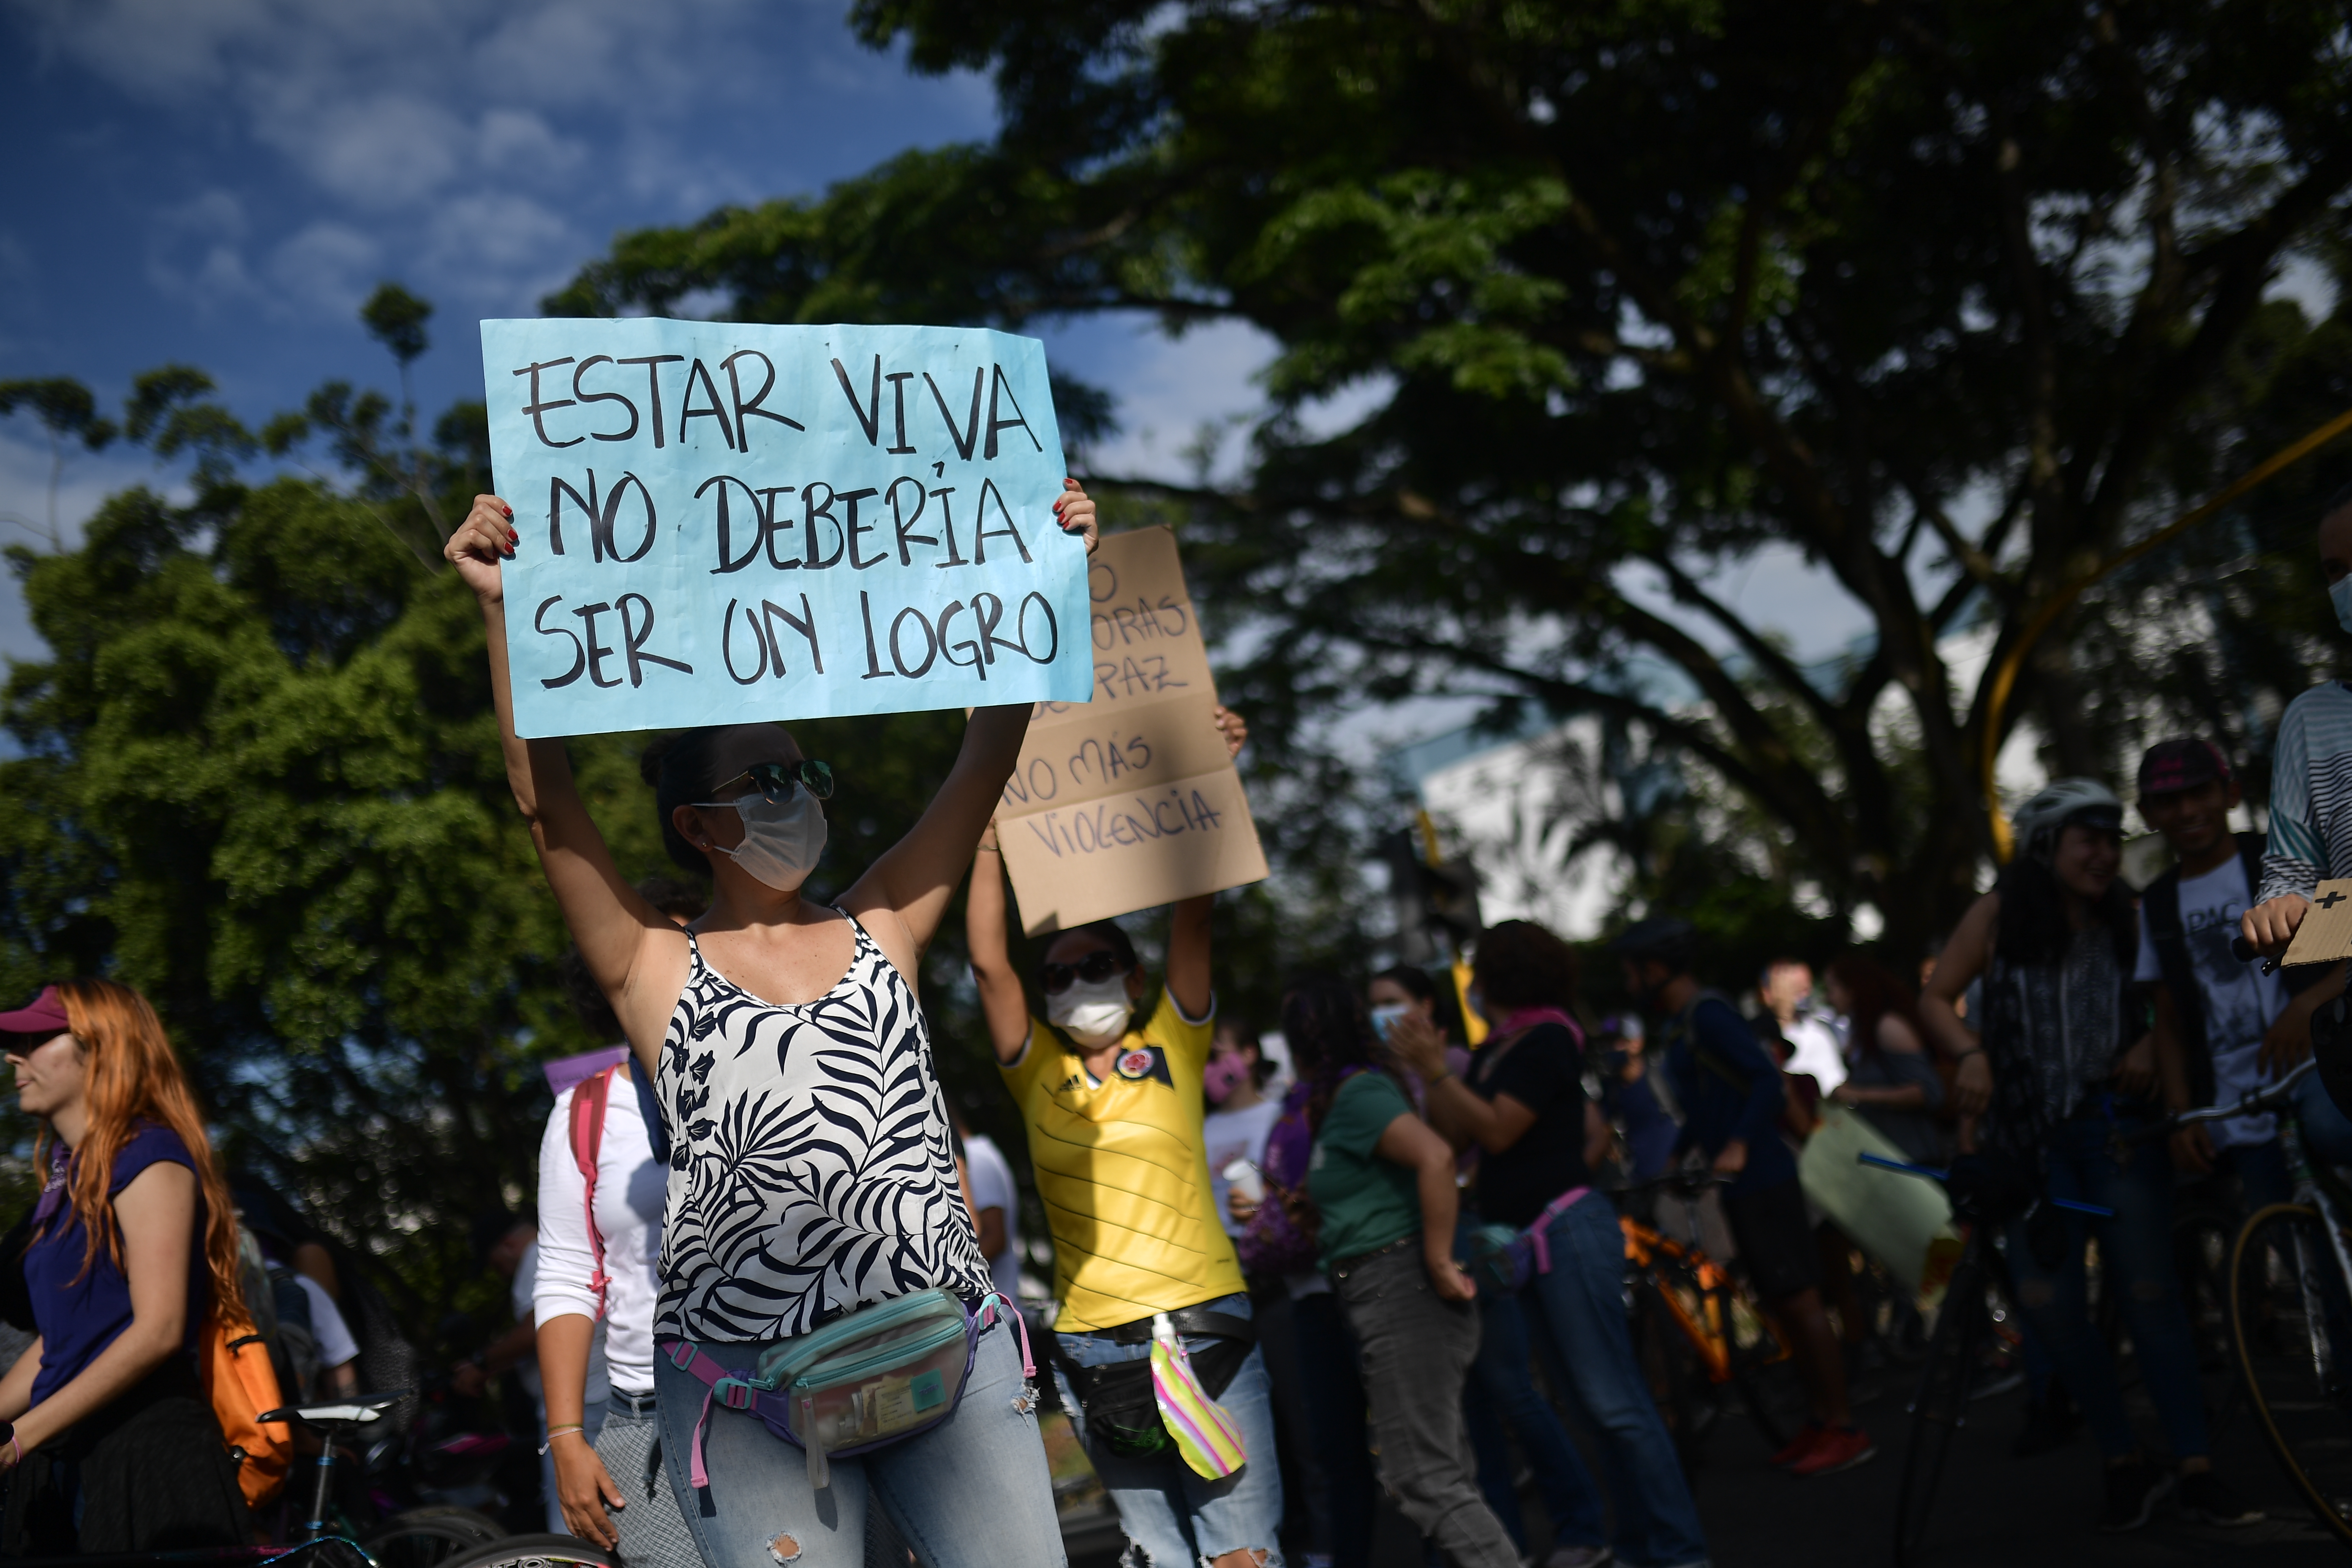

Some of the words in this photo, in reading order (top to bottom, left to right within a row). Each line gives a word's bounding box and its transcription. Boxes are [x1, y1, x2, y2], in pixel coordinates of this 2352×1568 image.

[513, 350, 805, 453] ESTAR
[831, 354, 1043, 461] VIVA
[549, 468, 656, 564] NO
[694, 461, 1032, 574] DEBERÍA
[534, 593, 693, 689] SER
[722, 593, 823, 686] UN
[860, 591, 1058, 681] LOGRO
[1091, 596, 1186, 651] ORAS
[1093, 656, 1188, 699] PAZ
[1003, 759, 1055, 806] NO
